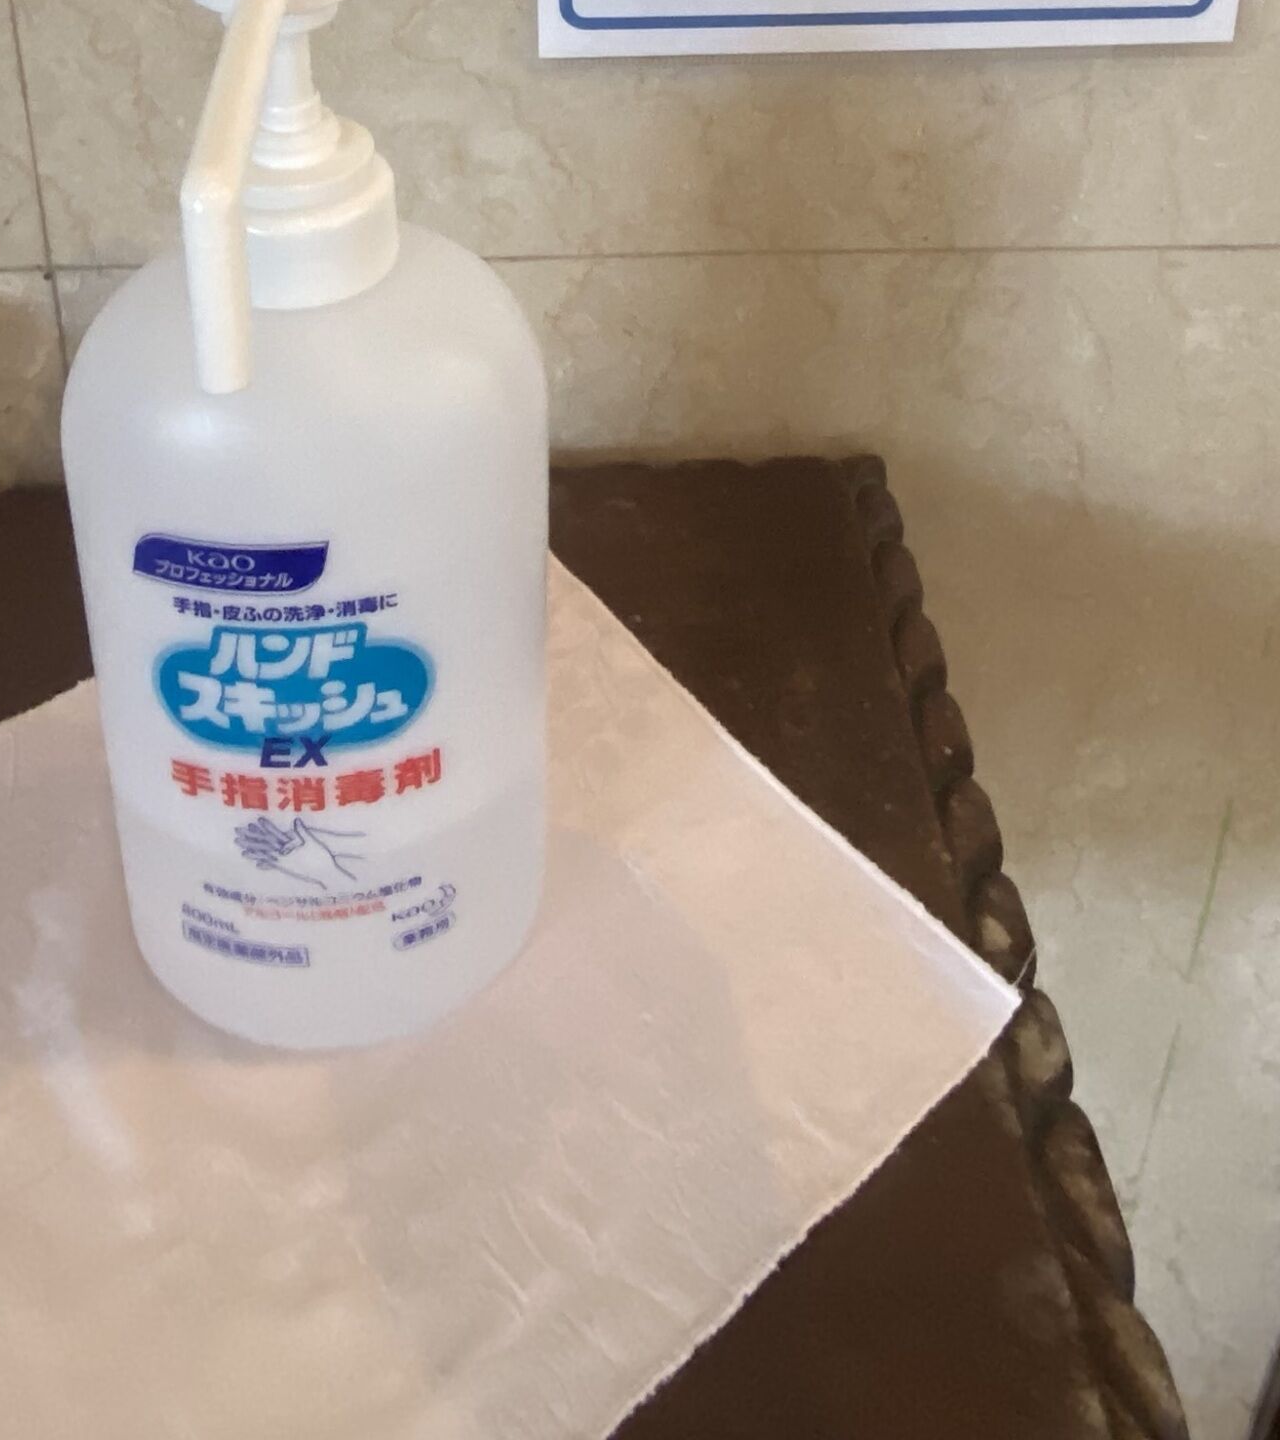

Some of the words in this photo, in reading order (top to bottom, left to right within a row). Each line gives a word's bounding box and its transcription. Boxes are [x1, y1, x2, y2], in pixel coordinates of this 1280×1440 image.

[154, 560, 294, 588] プロフェッショナル
[209, 629, 360, 680] ハンド
[177, 673, 409, 734] スキッシュ
[259, 735, 330, 769] EX
[171, 747, 443, 814] 手指消毒剤
